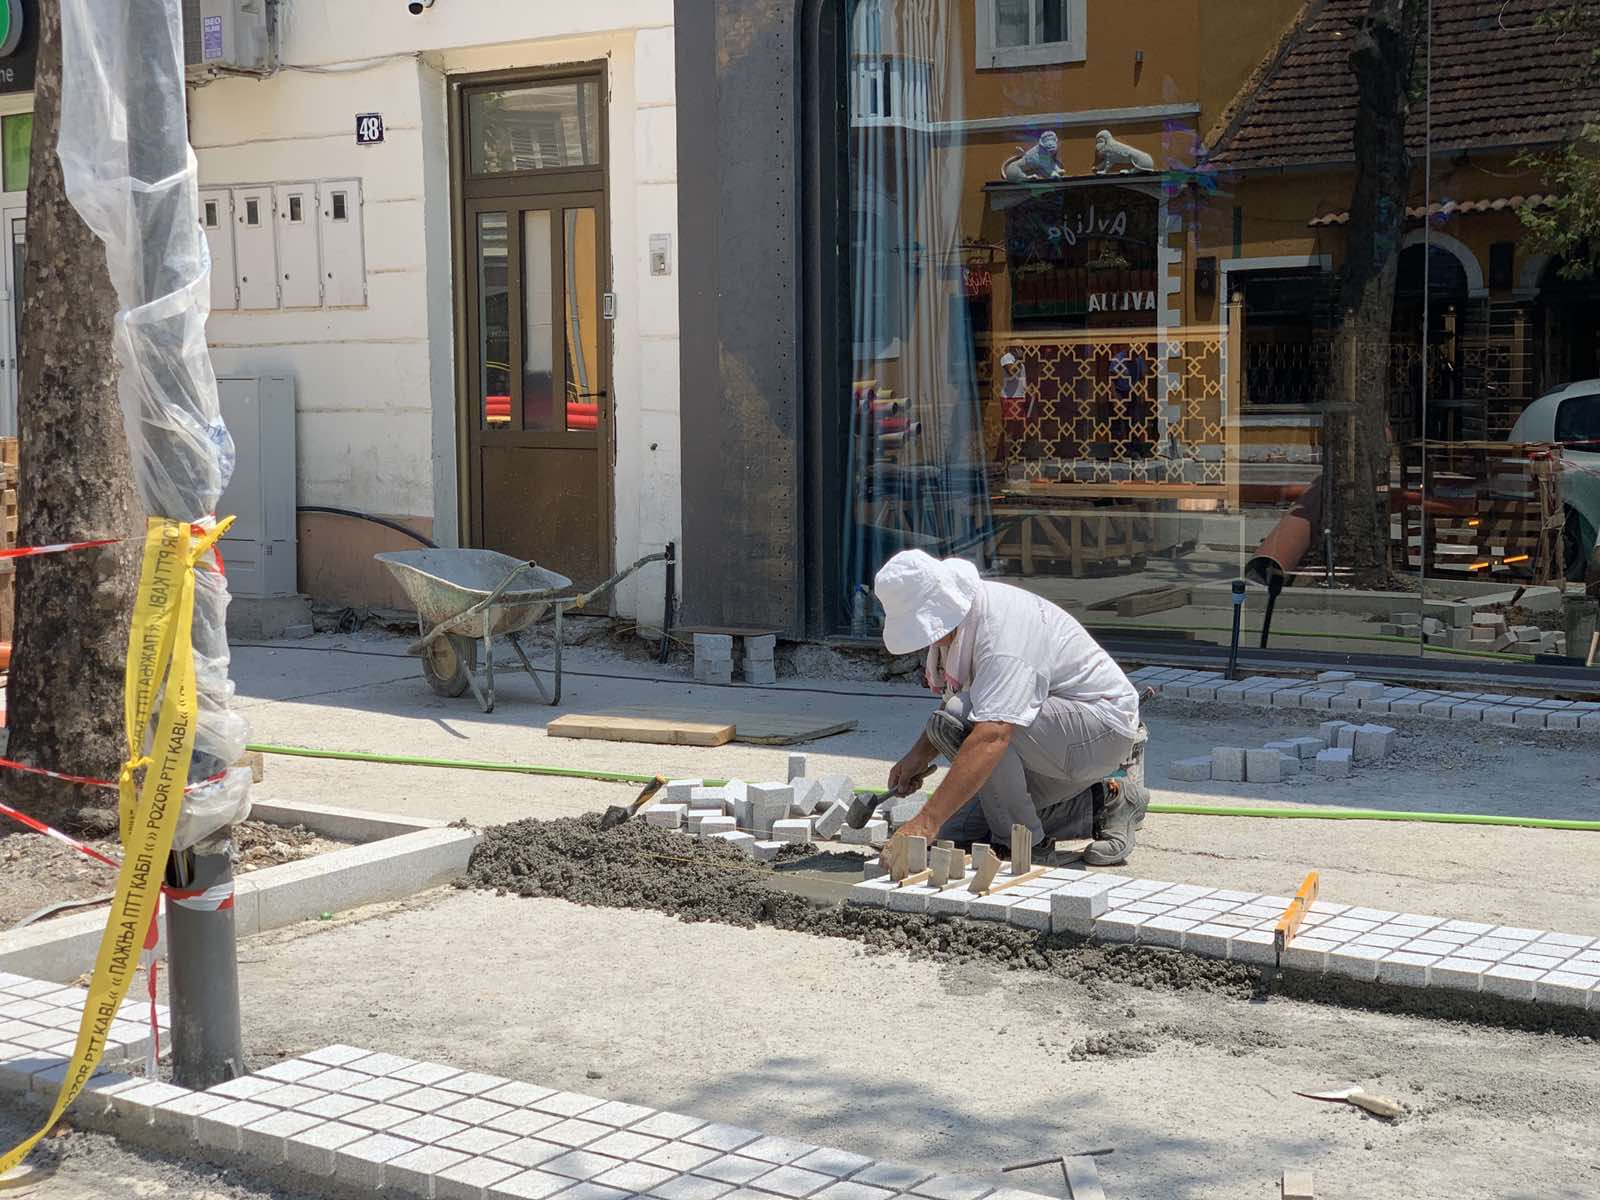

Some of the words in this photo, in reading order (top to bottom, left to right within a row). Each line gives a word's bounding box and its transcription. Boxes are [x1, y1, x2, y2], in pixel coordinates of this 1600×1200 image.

[359, 117, 379, 141] 48
[167, 719, 188, 754] KABL
[160, 756, 178, 782] PTT
[146, 783, 170, 829] POZOR
[129, 854, 153, 890] КАБЛ
[123, 891, 144, 918] ПТТ
[108, 921, 138, 974] ПАЖЊА
[93, 999, 117, 1035] KABL
[85, 1036, 102, 1063] PTT
